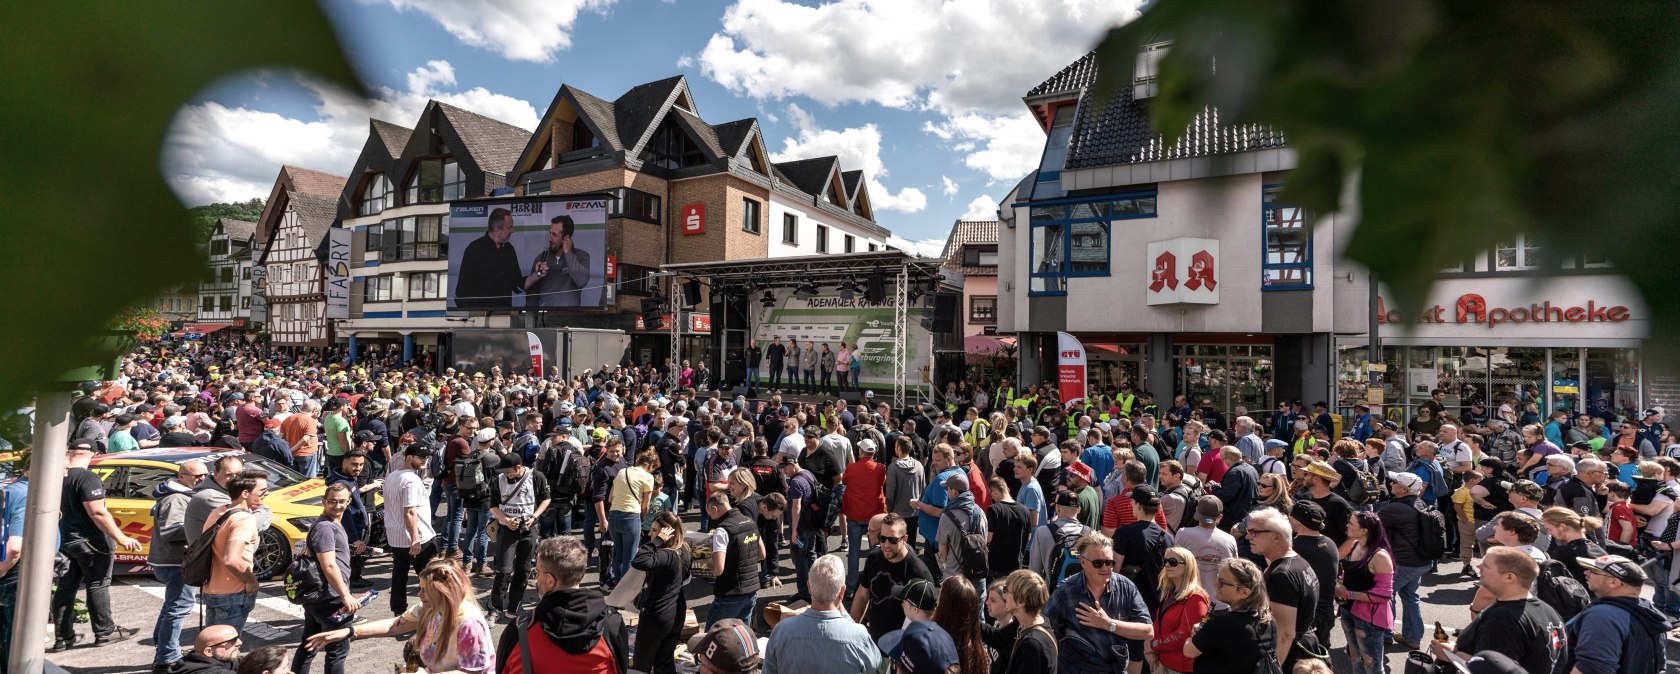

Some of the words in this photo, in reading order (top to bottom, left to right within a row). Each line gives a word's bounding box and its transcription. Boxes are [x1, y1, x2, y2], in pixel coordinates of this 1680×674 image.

[330, 239, 349, 299] FABRY
[1149, 250, 1179, 293] A
[1184, 249, 1218, 293] A
[807, 297, 856, 309] ADENAUER
[857, 297, 895, 309] RANG
[1456, 293, 1631, 328] Apotheke
[861, 353, 896, 364] burgring
[1061, 350, 1081, 358] GTÜ
[705, 641, 718, 660] 8
